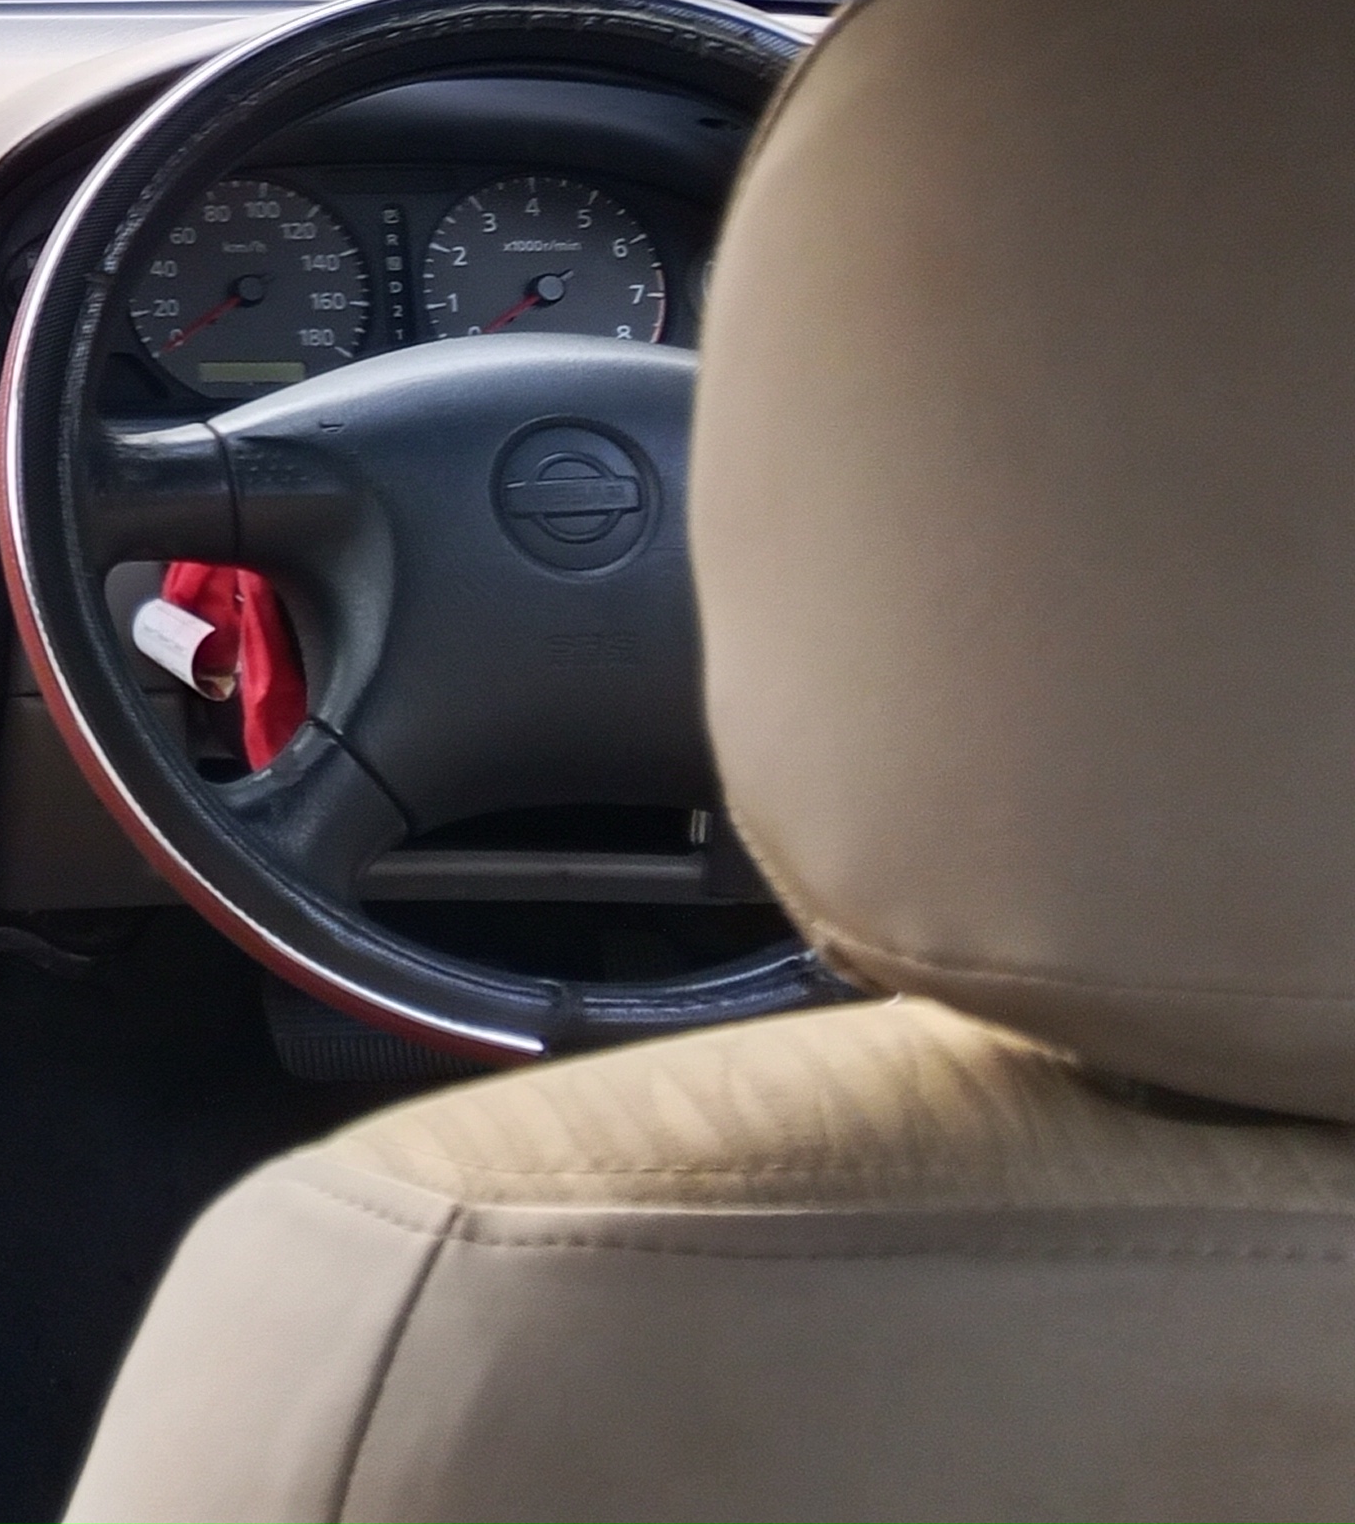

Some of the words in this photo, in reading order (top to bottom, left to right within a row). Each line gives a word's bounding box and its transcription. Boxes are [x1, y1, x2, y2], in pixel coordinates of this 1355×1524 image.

[203, 204, 232, 223] 80
[243, 200, 281, 218] 100
[524, 197, 541, 217] 4
[481, 213, 498, 233] 3
[577, 208, 593, 229] 5
[169, 227, 198, 245] 60
[280, 222, 318, 240] 120
[452, 246, 468, 267] 2
[612, 238, 629, 258] 6
[149, 260, 178, 278] 40
[300, 255, 341, 271] 140
[309, 292, 347, 310] 160
[446, 293, 459, 313] 1
[628, 284, 646, 305] 7
[152, 299, 180, 317] 20
[392, 304, 404, 318] 2
[298, 328, 334, 347] 180
[395, 328, 404, 341] 1
